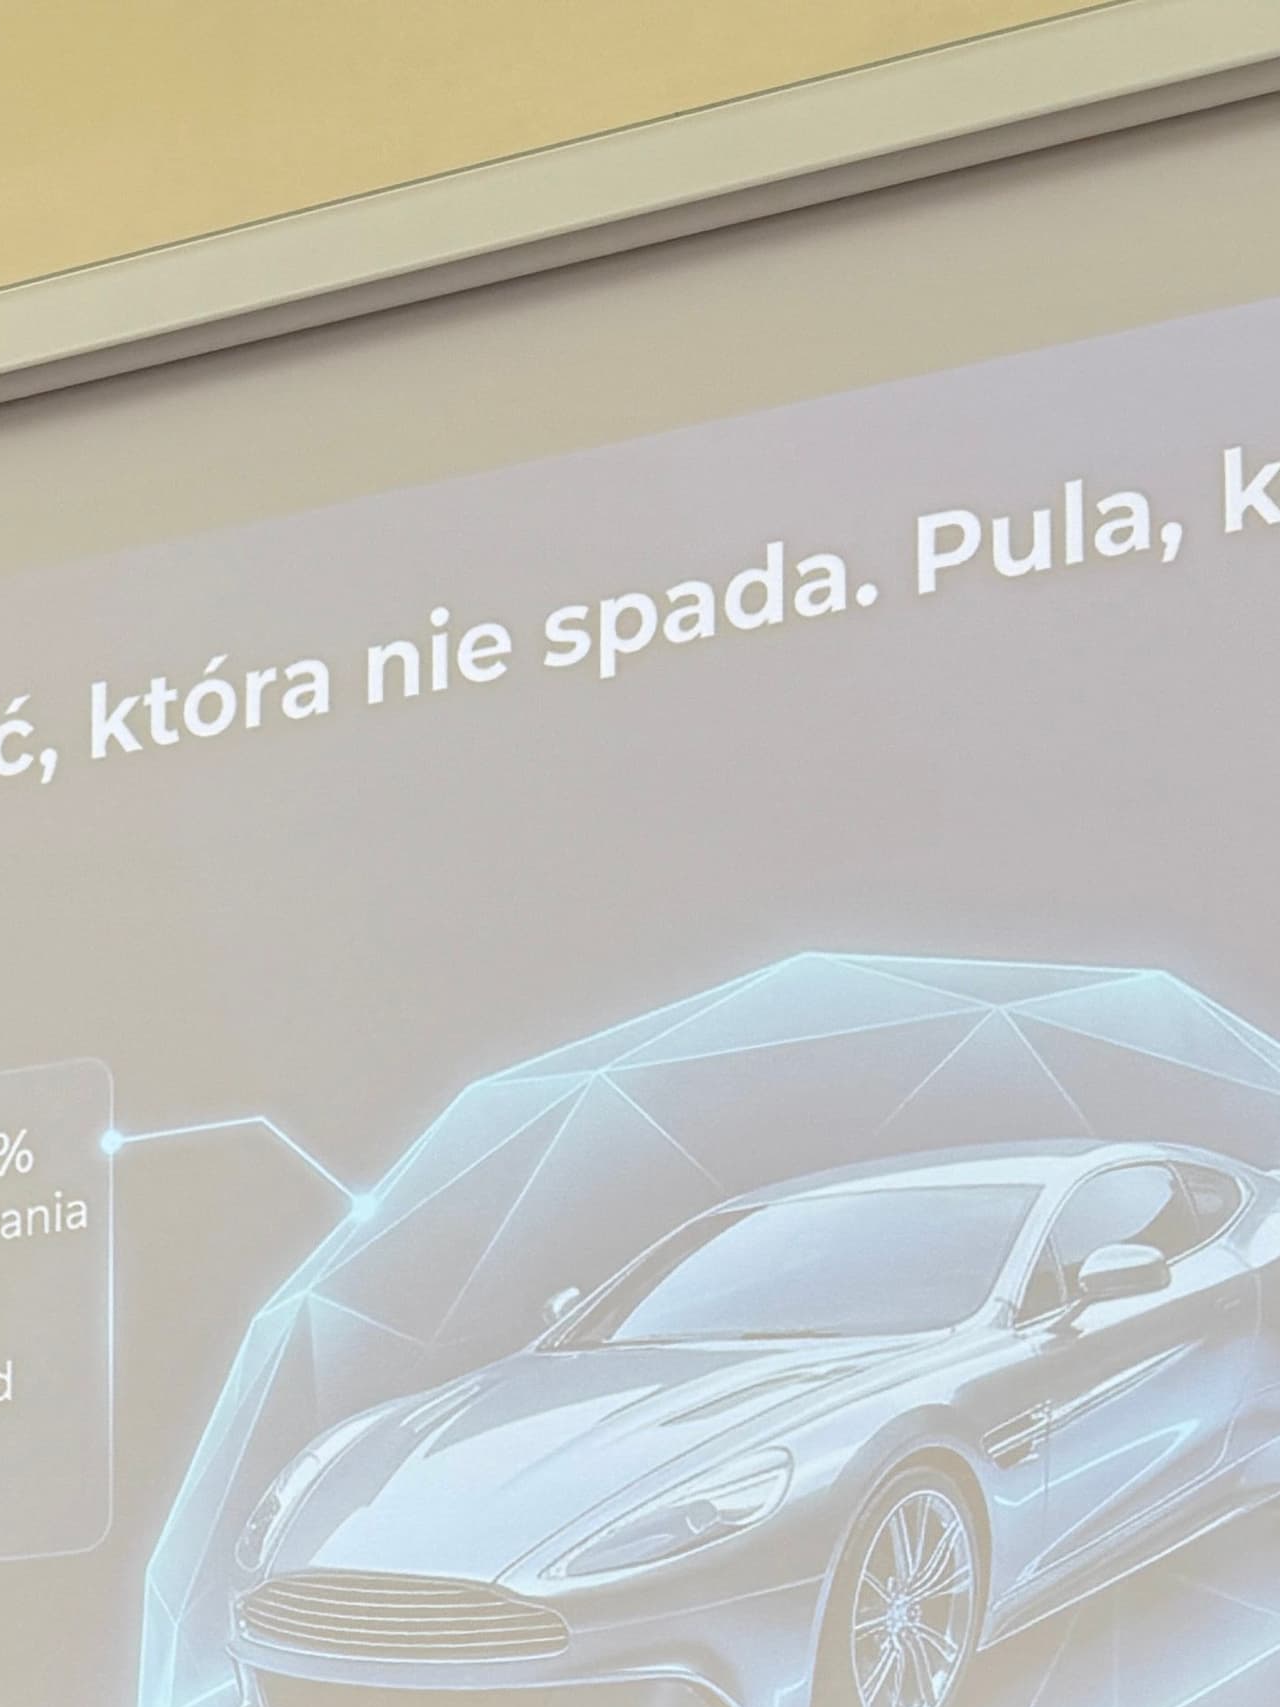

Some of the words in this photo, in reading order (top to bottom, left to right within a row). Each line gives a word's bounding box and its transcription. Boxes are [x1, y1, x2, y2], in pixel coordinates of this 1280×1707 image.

[92, 655, 328, 758] która
[368, 607, 511, 704] nie
[544, 542, 877, 678] spada.
[918, 480, 1182, 594] Pula,
